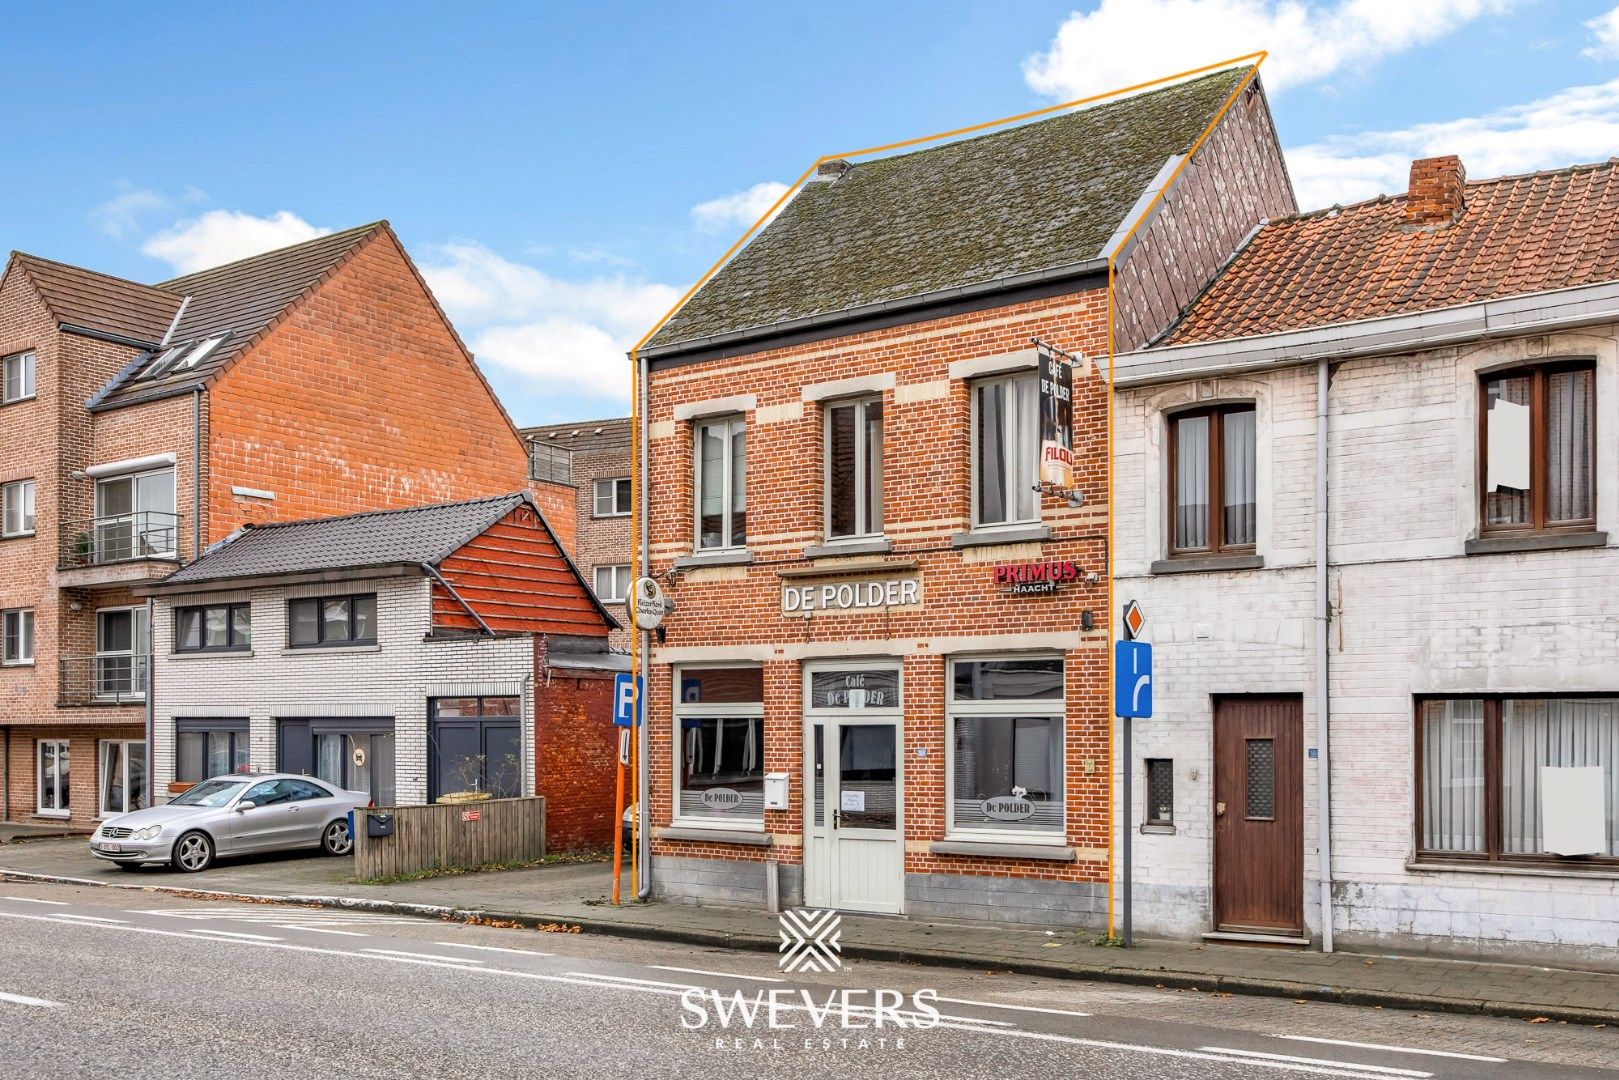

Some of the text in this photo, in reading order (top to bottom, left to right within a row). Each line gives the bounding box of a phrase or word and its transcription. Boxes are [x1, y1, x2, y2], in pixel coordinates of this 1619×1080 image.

[1041, 378, 1070, 401] DE POLDER
[1045, 446, 1073, 467] FILOU
[993, 560, 1077, 584] PRIMUS
[784, 579, 918, 612] DE POLDER
[1013, 584, 1055, 594] HAACHT
[845, 673, 865, 688] Café
[618, 681, 640, 719] P
[827, 689, 885, 706] De PDER
[704, 793, 739, 803] De POLDER
[986, 802, 1030, 814] De POLDER
